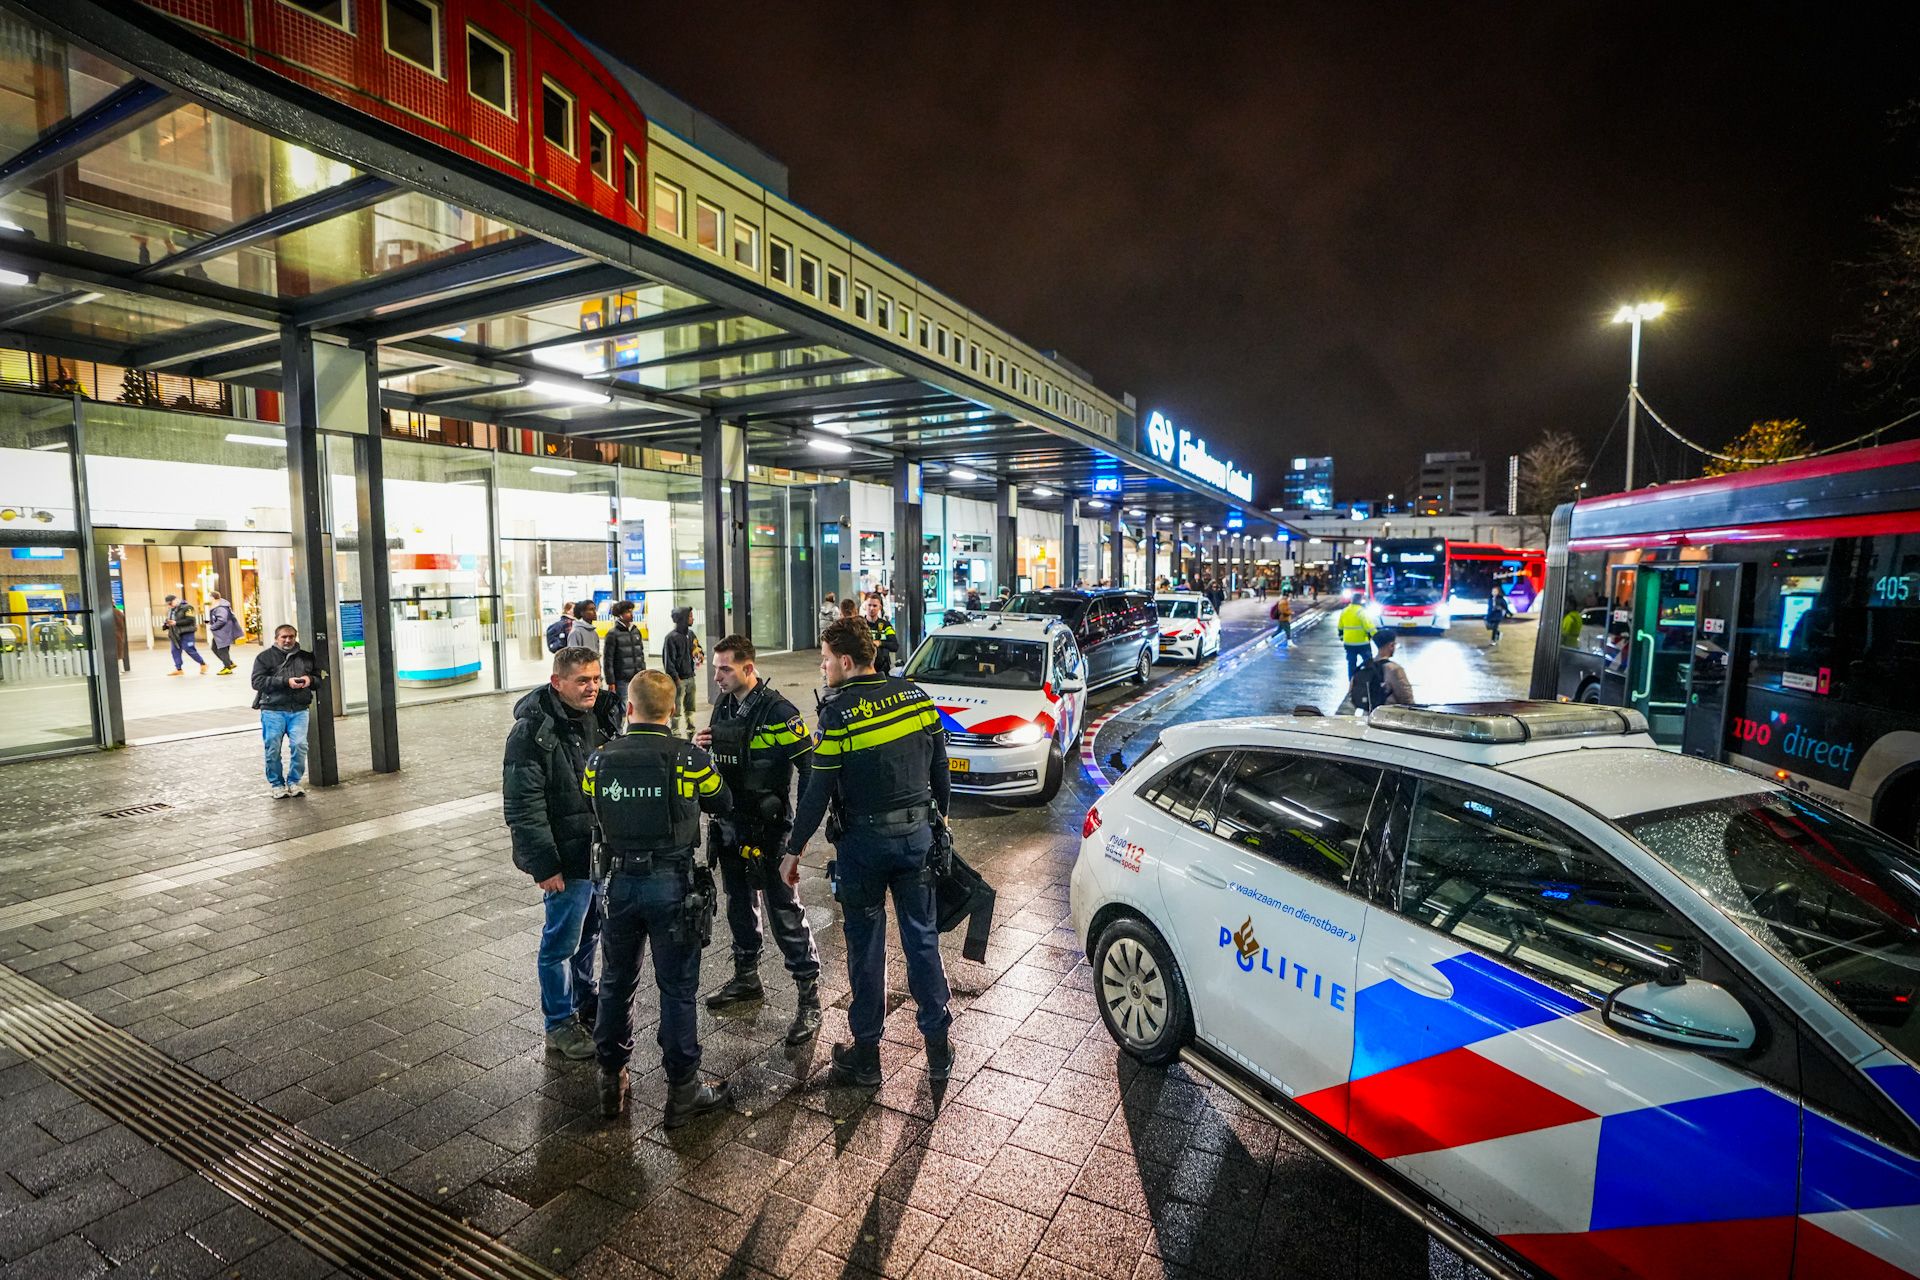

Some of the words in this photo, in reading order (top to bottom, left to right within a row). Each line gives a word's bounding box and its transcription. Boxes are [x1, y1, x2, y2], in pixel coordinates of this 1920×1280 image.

[1876, 576, 1911, 600] 405
[851, 691, 906, 719] POLITIE
[714, 754, 738, 765] LITIE
[1783, 724, 1855, 771] direct
[602, 782, 662, 802] POLITIE
[1125, 842, 1145, 864] 112
[1121, 859, 1141, 873] spoed
[1236, 883, 1282, 910] waakzaam
[1282, 904, 1295, 916] en
[1295, 908, 1349, 939] dienstbaar
[1219, 925, 1347, 1012] POLITIE
